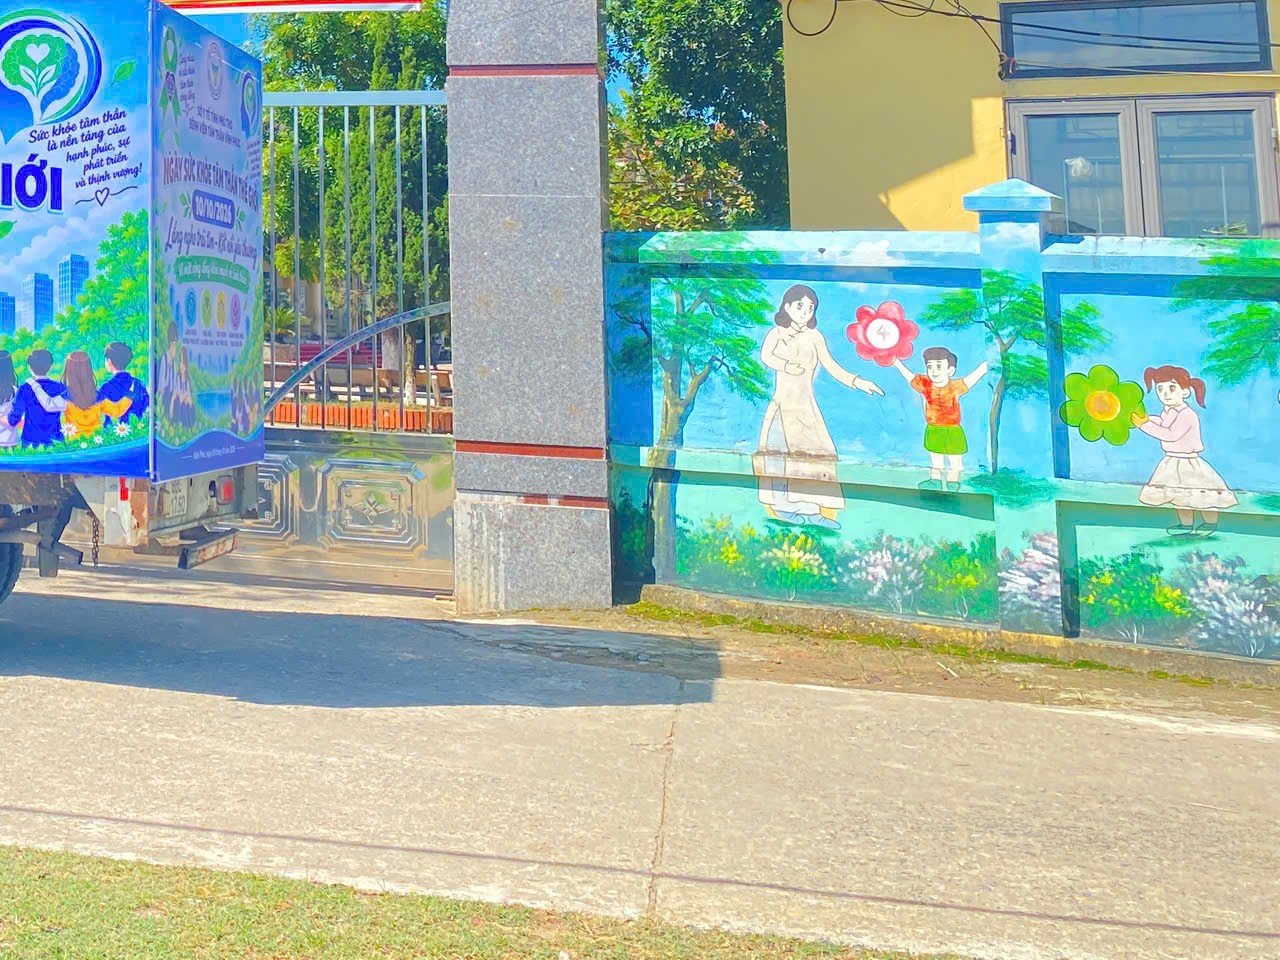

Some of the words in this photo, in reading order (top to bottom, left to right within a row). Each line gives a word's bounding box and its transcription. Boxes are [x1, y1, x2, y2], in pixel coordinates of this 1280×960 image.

[29, 129, 49, 143] Sức
[52, 123, 77, 137] khỏe
[79, 117, 100, 130] tâm
[103, 108, 127, 123] thần
[66, 150, 89, 162] hạnh
[91, 142, 115, 159] phúc,
[118, 137, 130, 148] sự
[75, 180, 86, 188] và
[88, 171, 111, 185] thịnh
[113, 162, 143, 178] vượng!
[83, 160, 104, 175] phát
[195, 195, 232, 224] 10/10/2026
